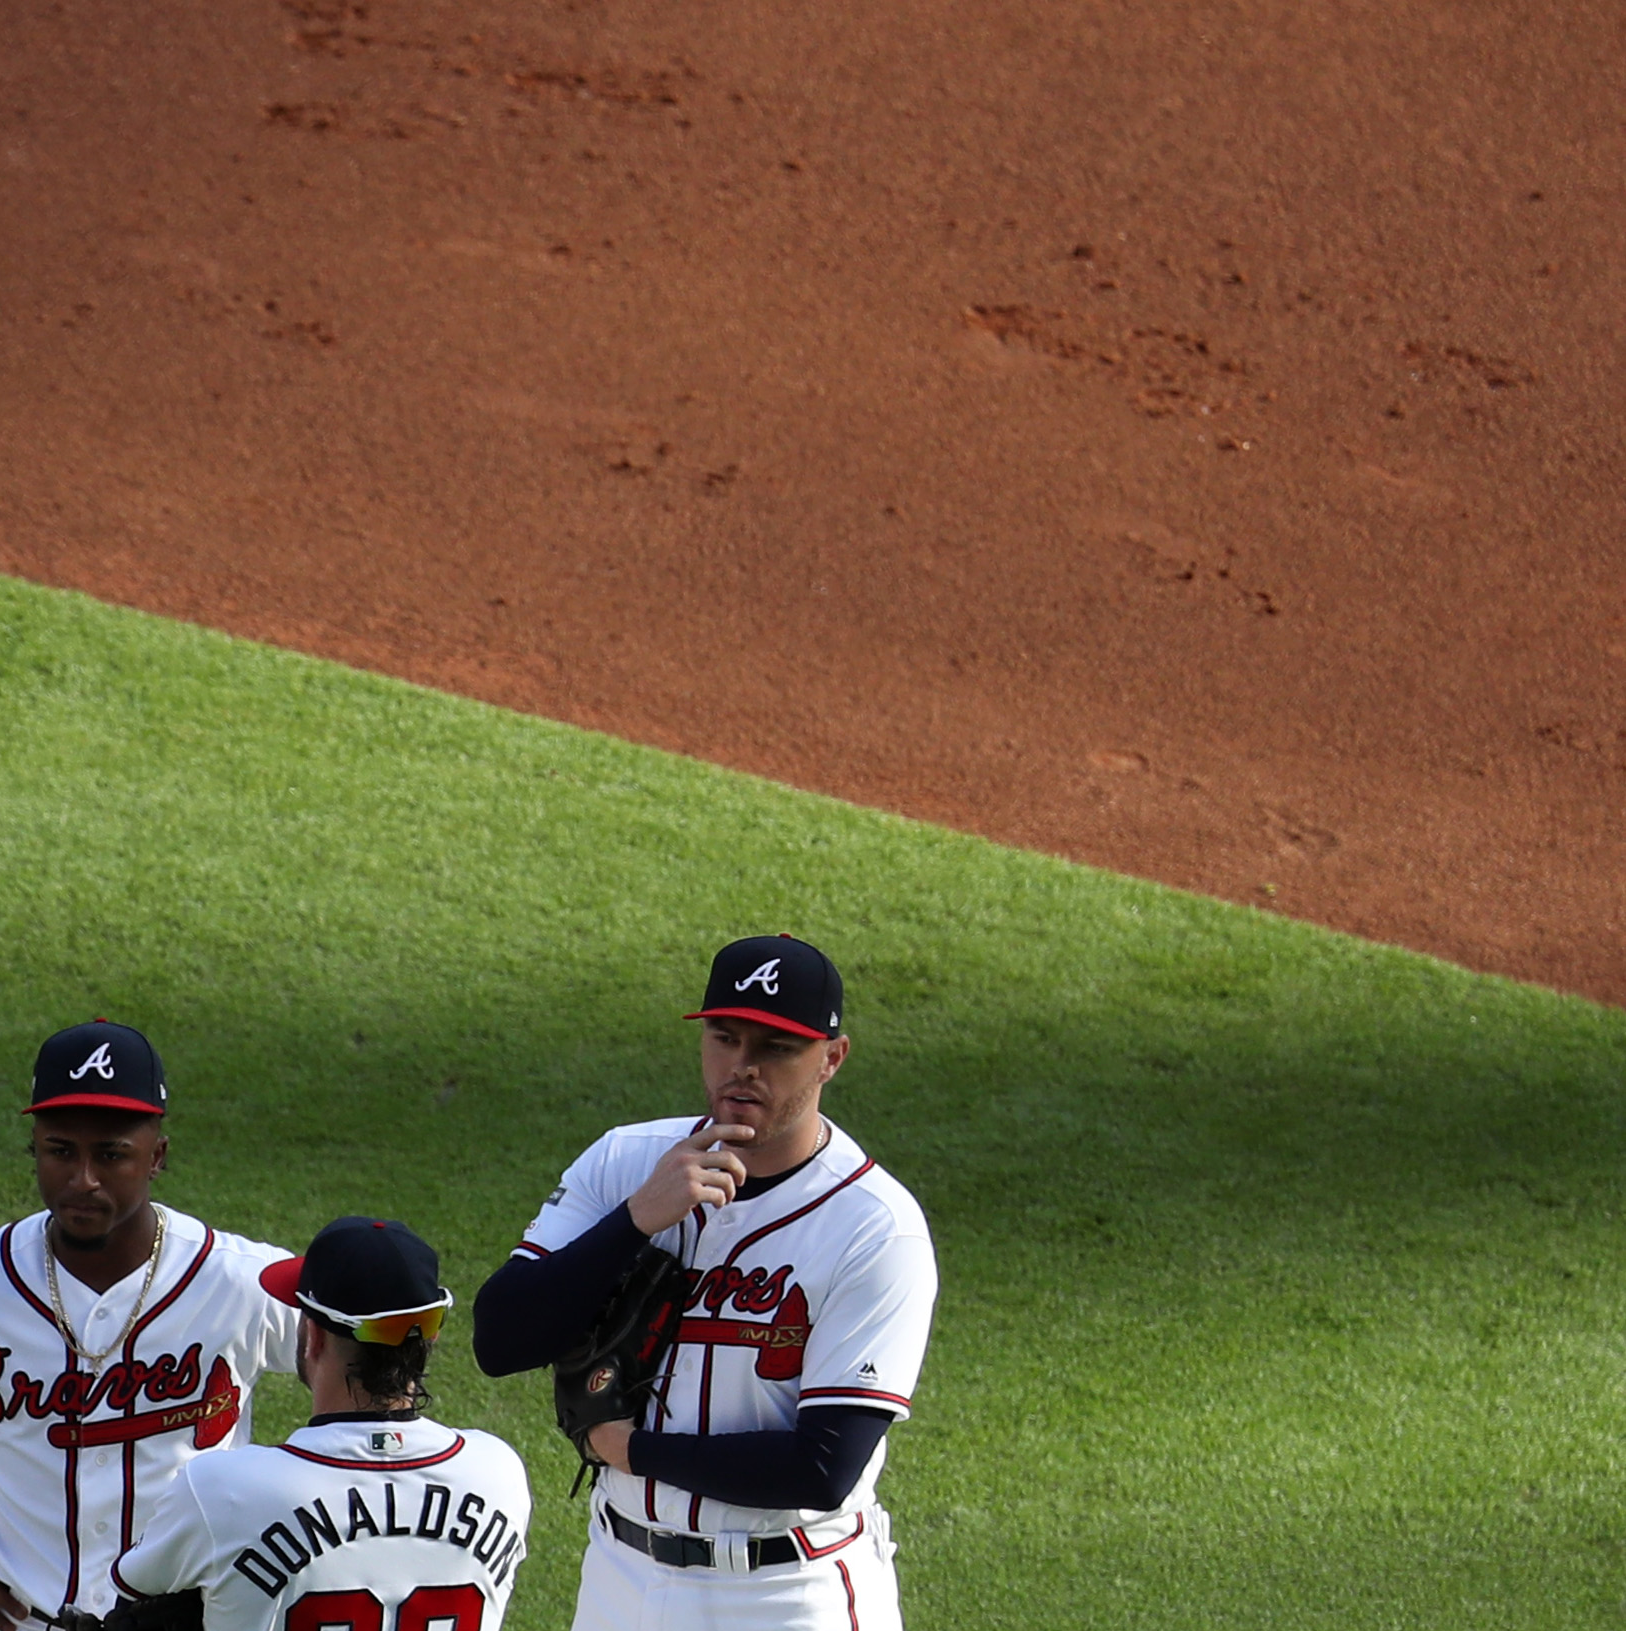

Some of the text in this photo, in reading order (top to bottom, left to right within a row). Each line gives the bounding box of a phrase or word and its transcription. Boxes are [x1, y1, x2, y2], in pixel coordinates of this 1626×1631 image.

[735, 958, 781, 995] A
[69, 1042, 115, 1080] A
[683, 1263, 795, 1315] ves
[233, 1482, 520, 1600] DONALDSON
